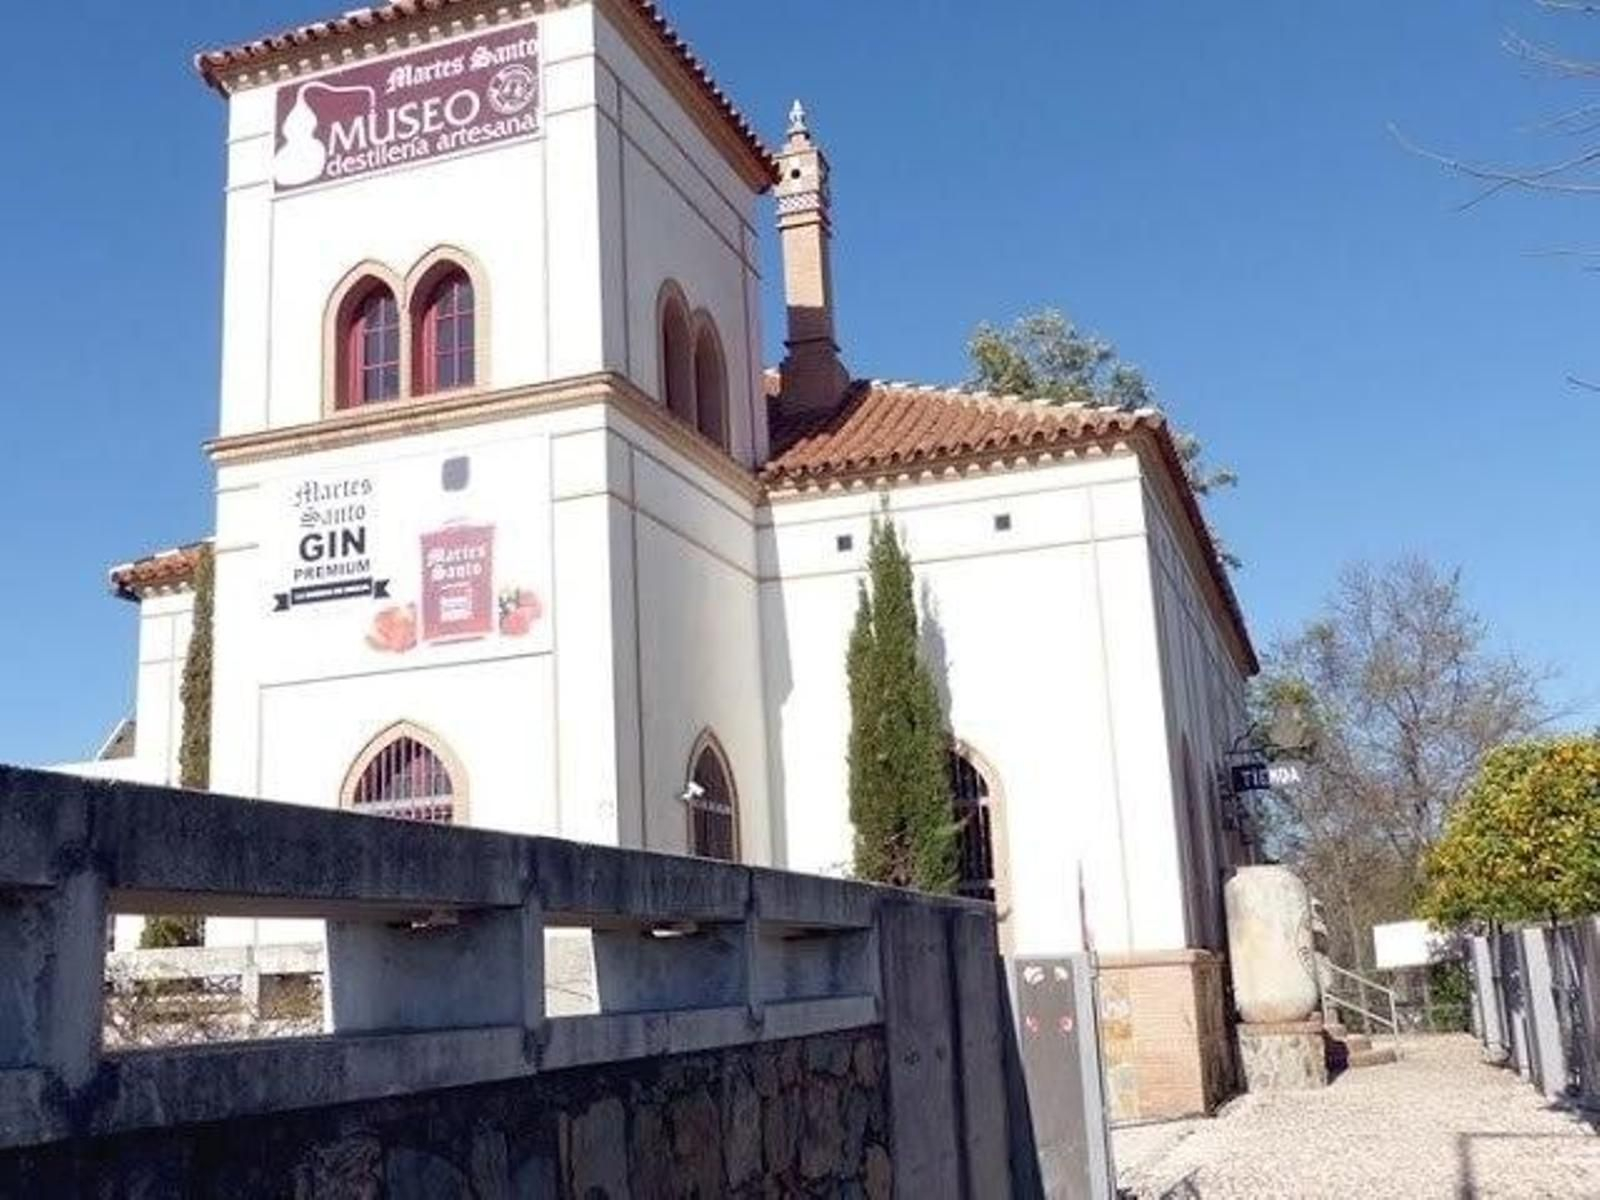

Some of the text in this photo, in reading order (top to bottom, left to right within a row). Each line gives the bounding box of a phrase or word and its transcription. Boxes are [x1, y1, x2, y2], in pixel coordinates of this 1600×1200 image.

[385, 56, 465, 93] Martes
[469, 38, 538, 69] Santo
[328, 88, 481, 155] MUSEO
[326, 137, 430, 176] destilería
[294, 479, 372, 507] Martes
[299, 504, 366, 528] Santo
[299, 526, 366, 562] GIN
[293, 560, 370, 581] PREMIUM
